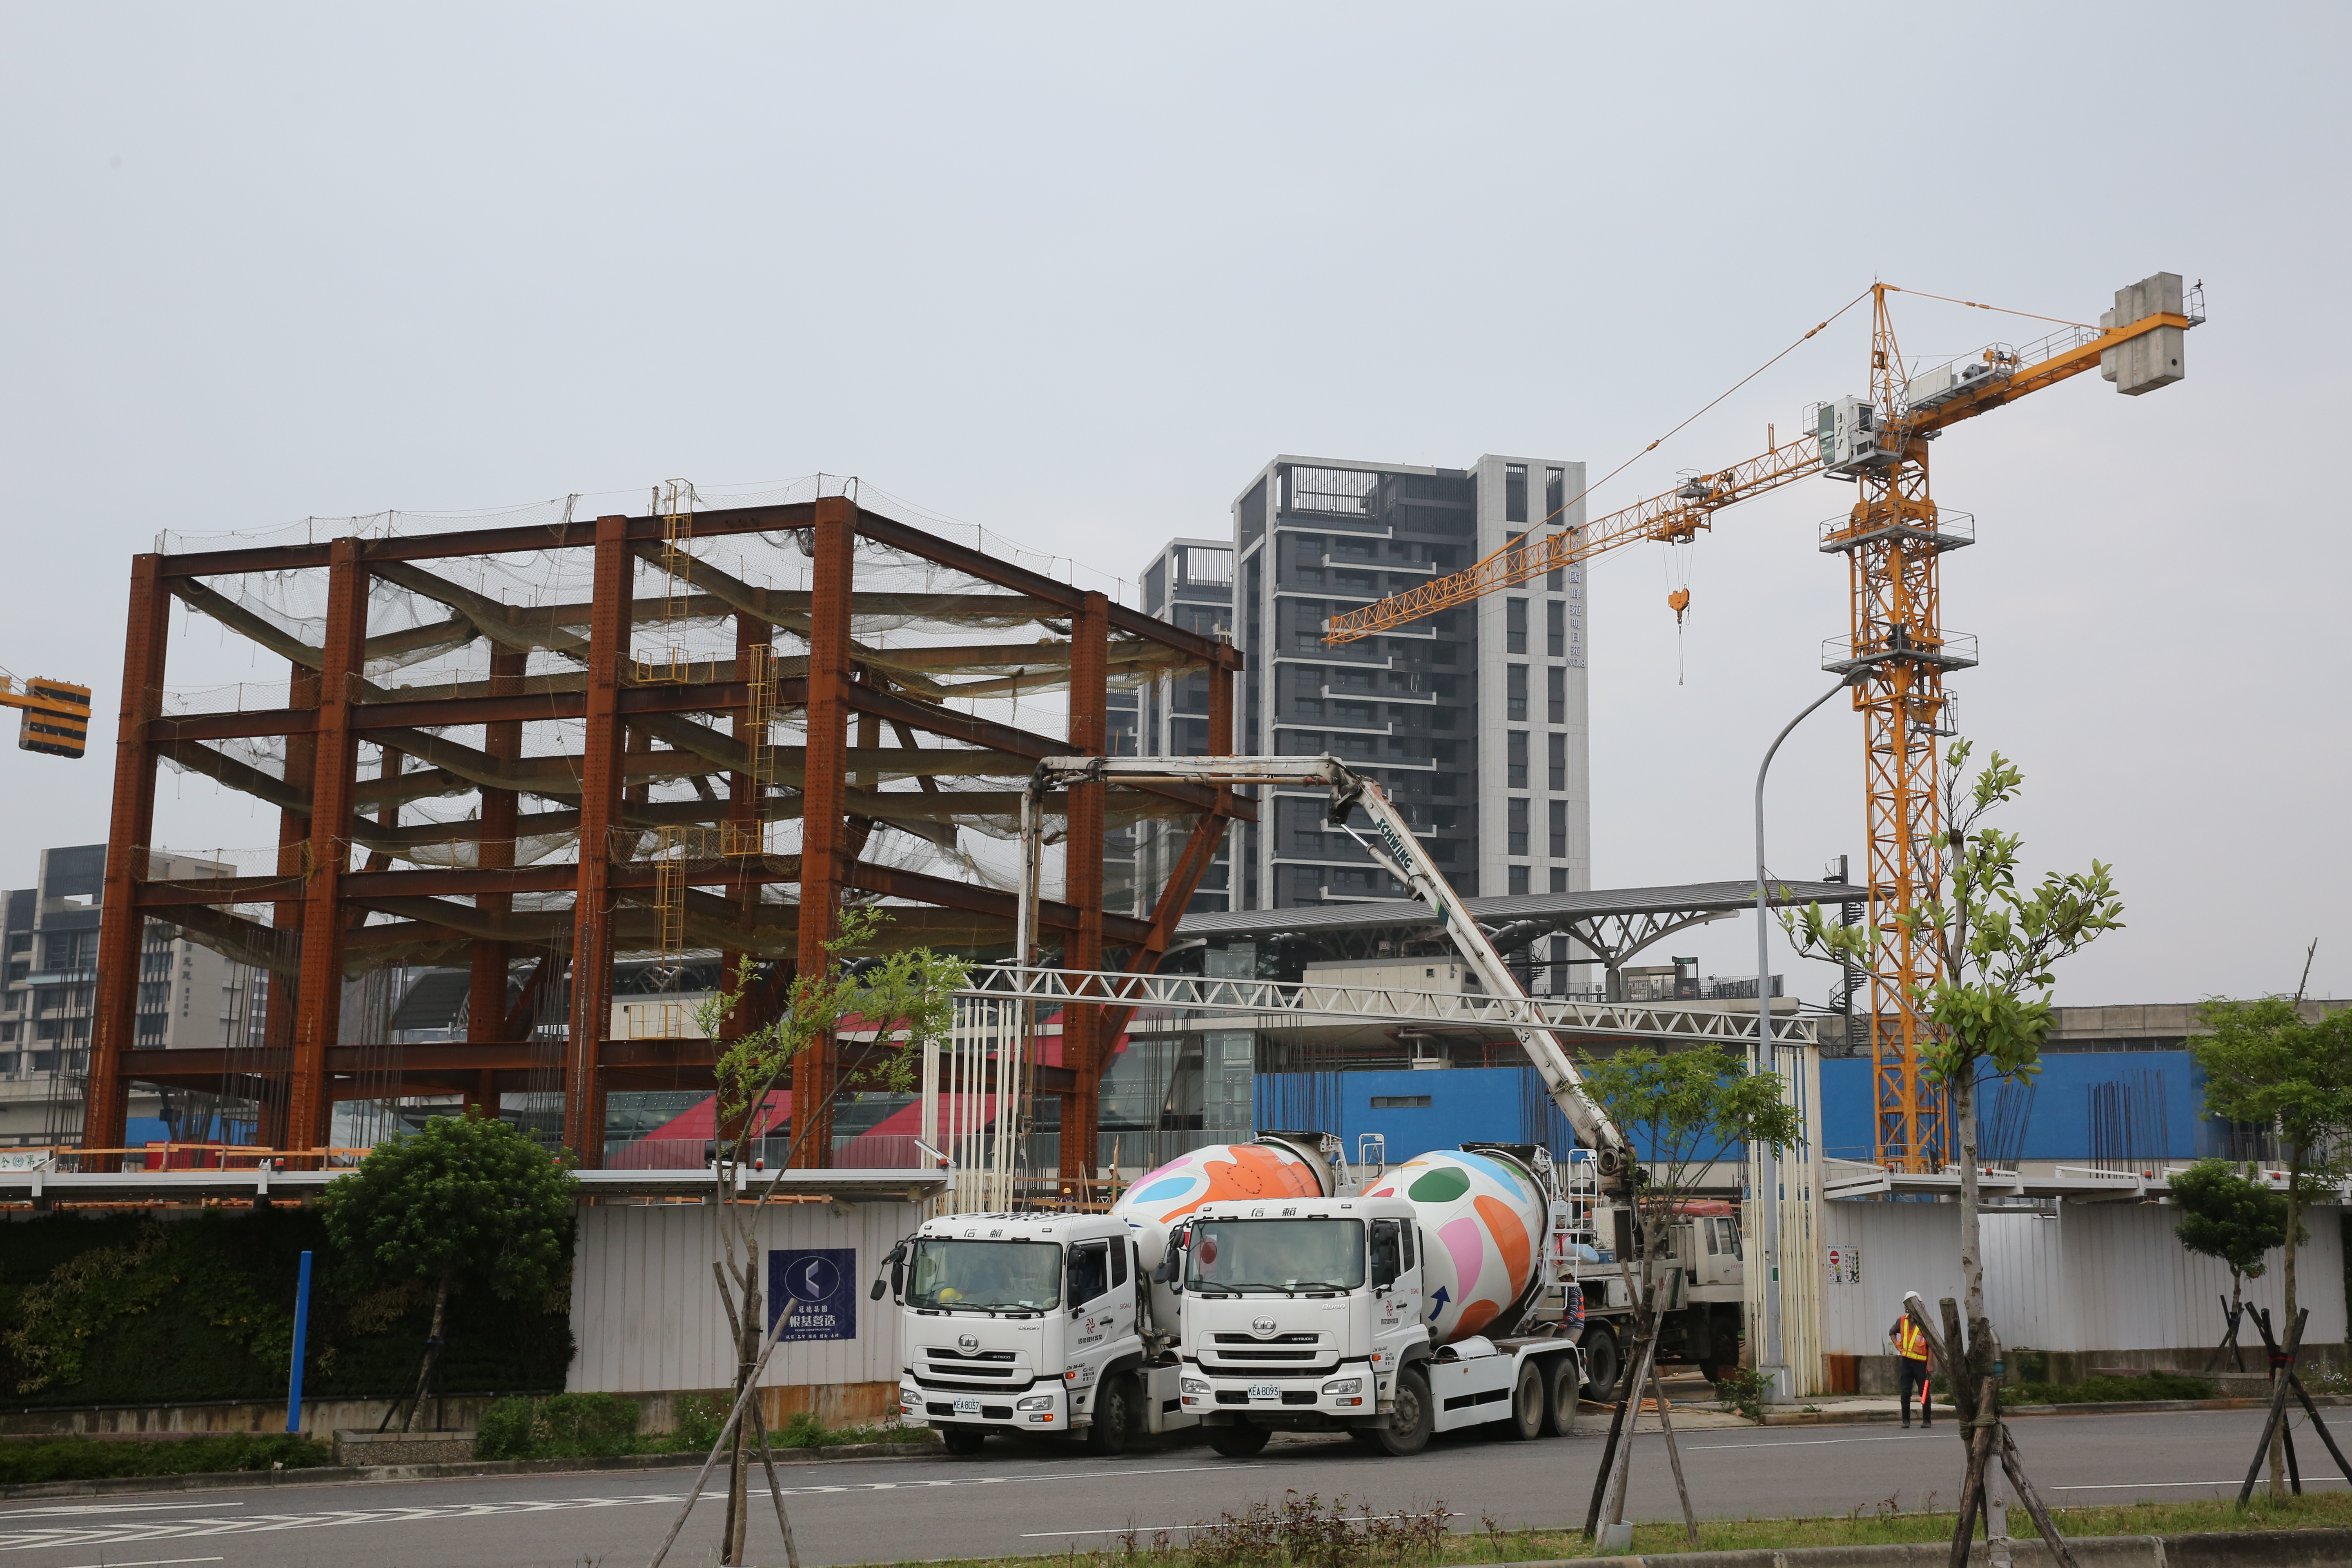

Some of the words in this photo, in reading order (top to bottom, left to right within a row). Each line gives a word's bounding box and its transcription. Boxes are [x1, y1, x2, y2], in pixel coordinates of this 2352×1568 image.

[1567, 657, 1586, 668] NO.8
[1376, 818, 1413, 869] SCHWING
[799, 1305, 828, 1313] 冠德集團
[789, 1315, 835, 1327] 根基營造
[1254, 1320, 1274, 1330] UD
[960, 1337, 977, 1347] UD
